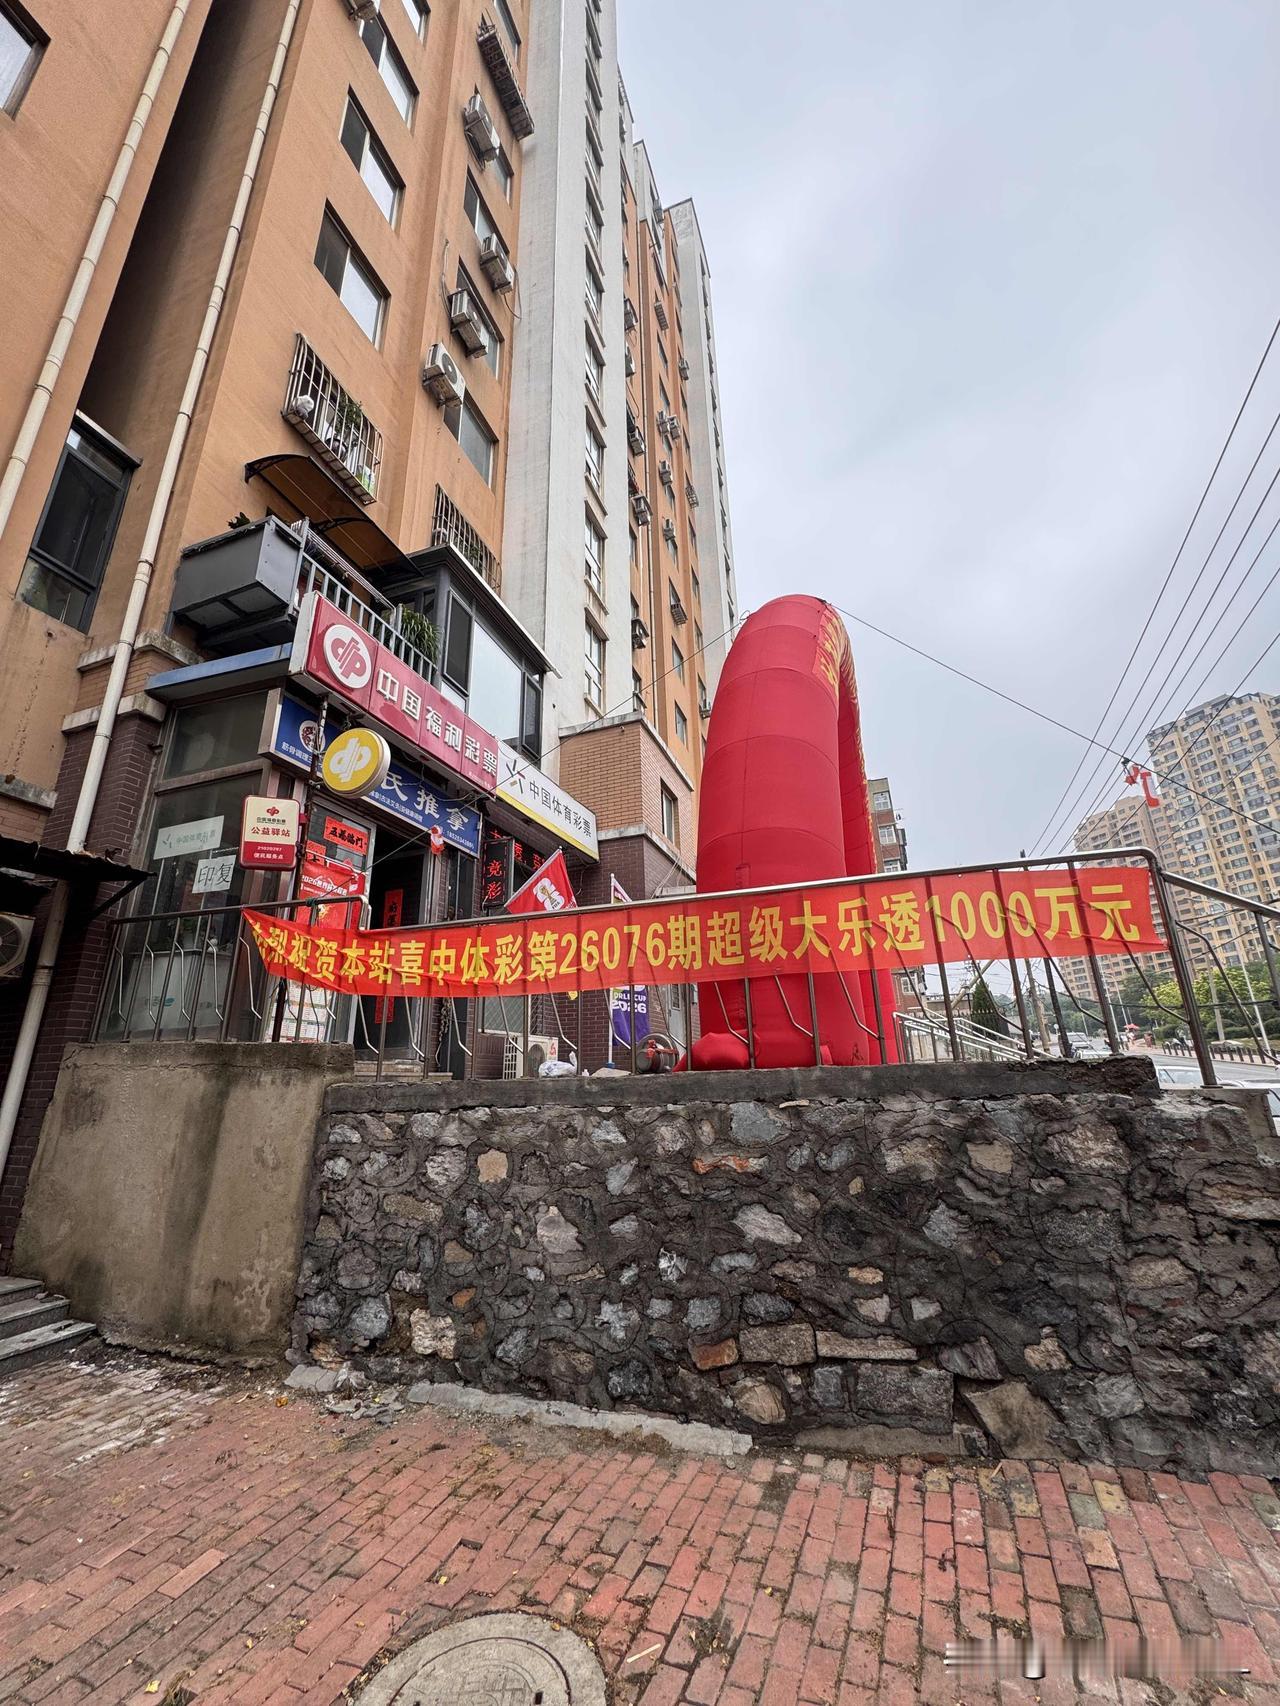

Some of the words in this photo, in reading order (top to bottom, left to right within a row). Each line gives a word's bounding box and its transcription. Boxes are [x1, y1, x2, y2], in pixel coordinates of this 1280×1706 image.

[376, 668, 497, 777] 中国福利彩票
[529, 779, 591, 838] 中国体育彩票
[487, 859, 503, 899] 竞彩
